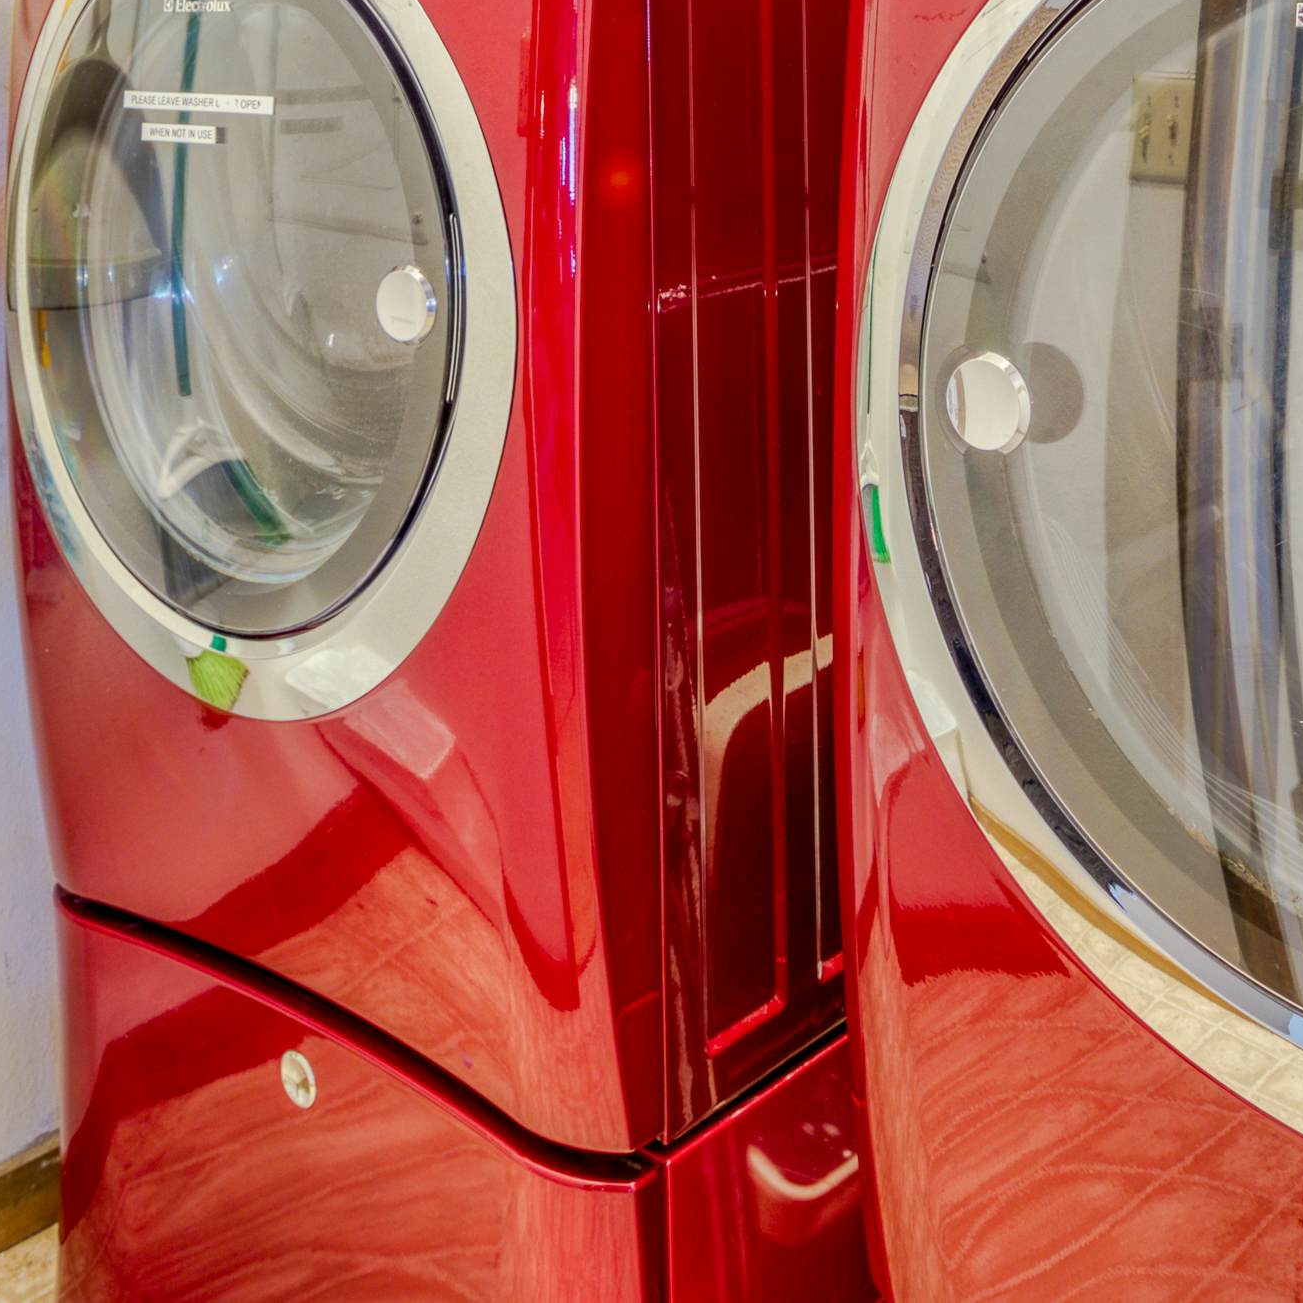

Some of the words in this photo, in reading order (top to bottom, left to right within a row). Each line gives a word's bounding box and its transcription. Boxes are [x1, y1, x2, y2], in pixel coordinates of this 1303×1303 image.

[131, 94, 156, 105] PLEASE
[158, 96, 180, 106] LEAVE
[182, 97, 214, 108] WASHER
[149, 128, 170, 137] WHEN
[172, 129, 187, 138] NOT
[188, 129, 195, 139] IN
[197, 129, 213, 139] USE
